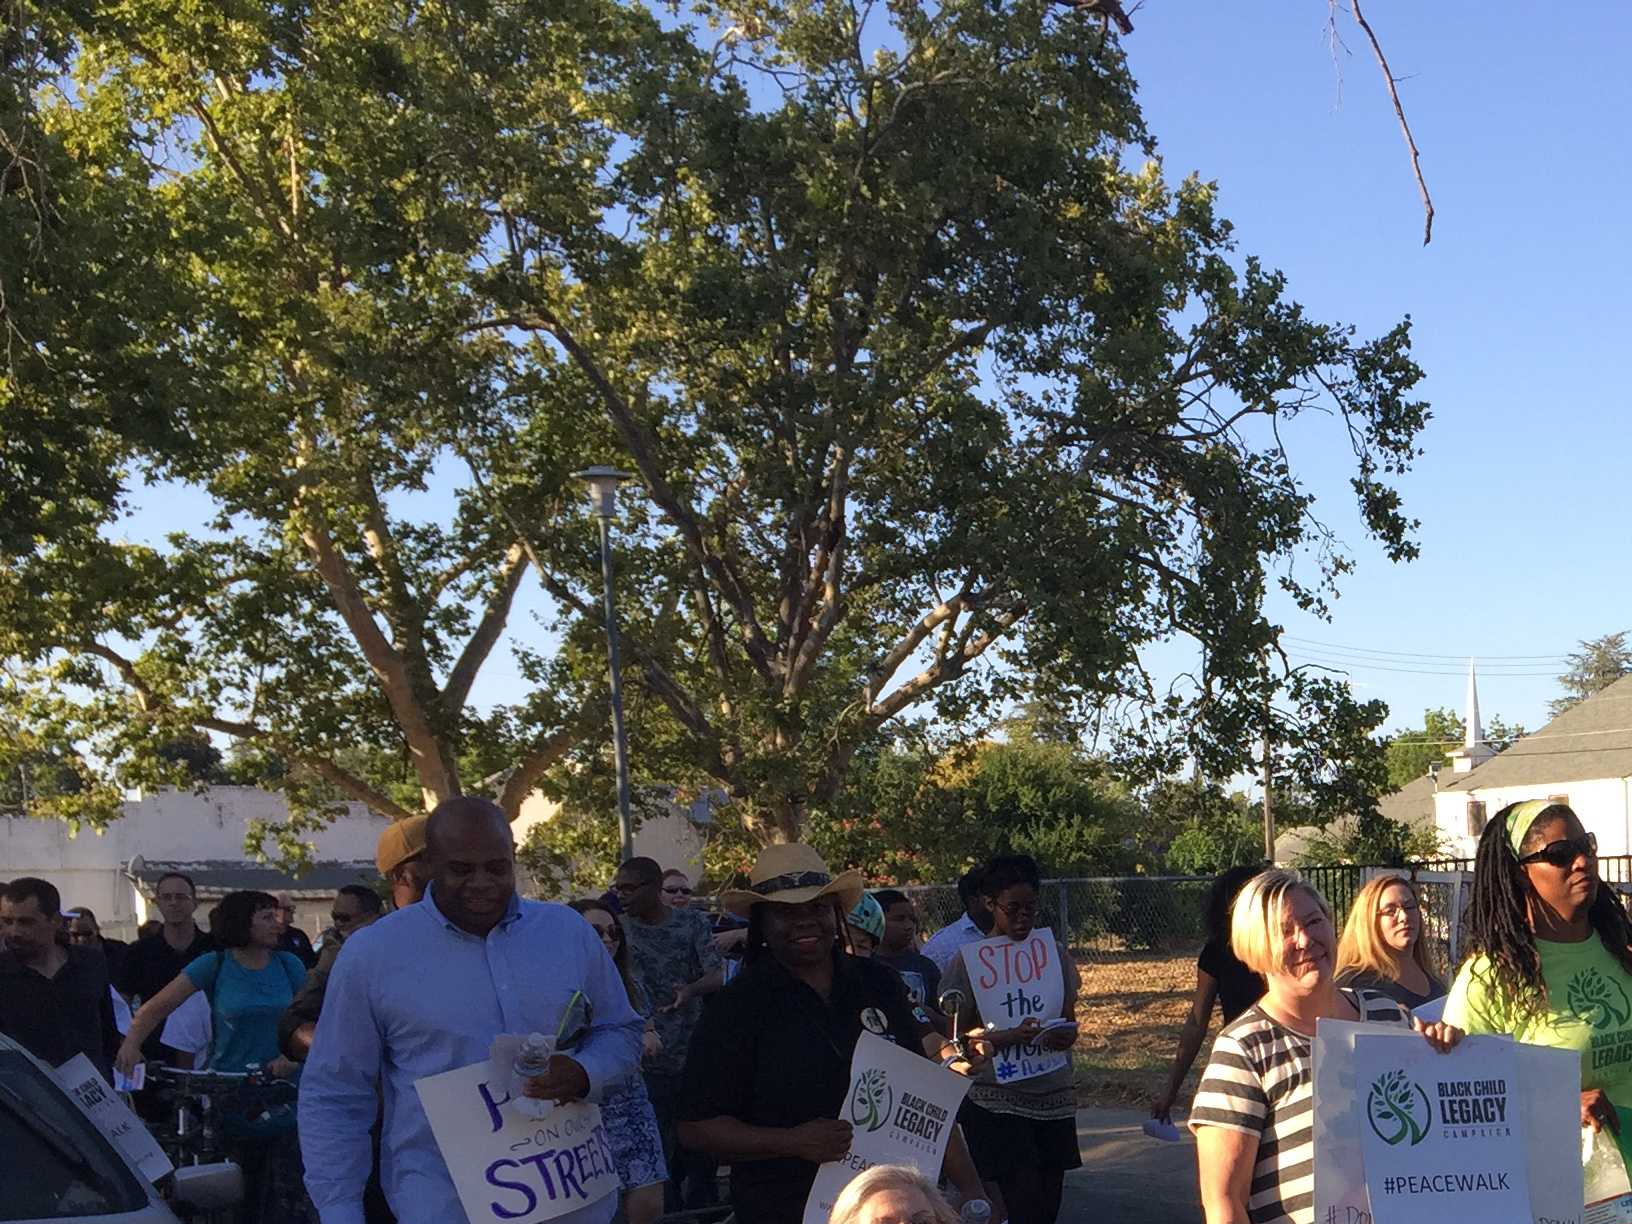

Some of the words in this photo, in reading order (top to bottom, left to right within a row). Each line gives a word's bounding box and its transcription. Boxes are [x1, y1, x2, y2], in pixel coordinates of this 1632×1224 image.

[978, 938, 1048, 989] STOP
[1000, 988, 1044, 1018] the
[1438, 1081, 1472, 1097] BLACK
[1474, 1080, 1506, 1096] CHILD
[901, 1092, 927, 1113] BLACK
[925, 1103, 949, 1122] CHILD
[1440, 1097, 1506, 1124] LEGACY
[534, 1128, 560, 1146] ON
[894, 1106, 943, 1143] LEGACY
[1384, 1172, 1510, 1194] #PEACEWALK
